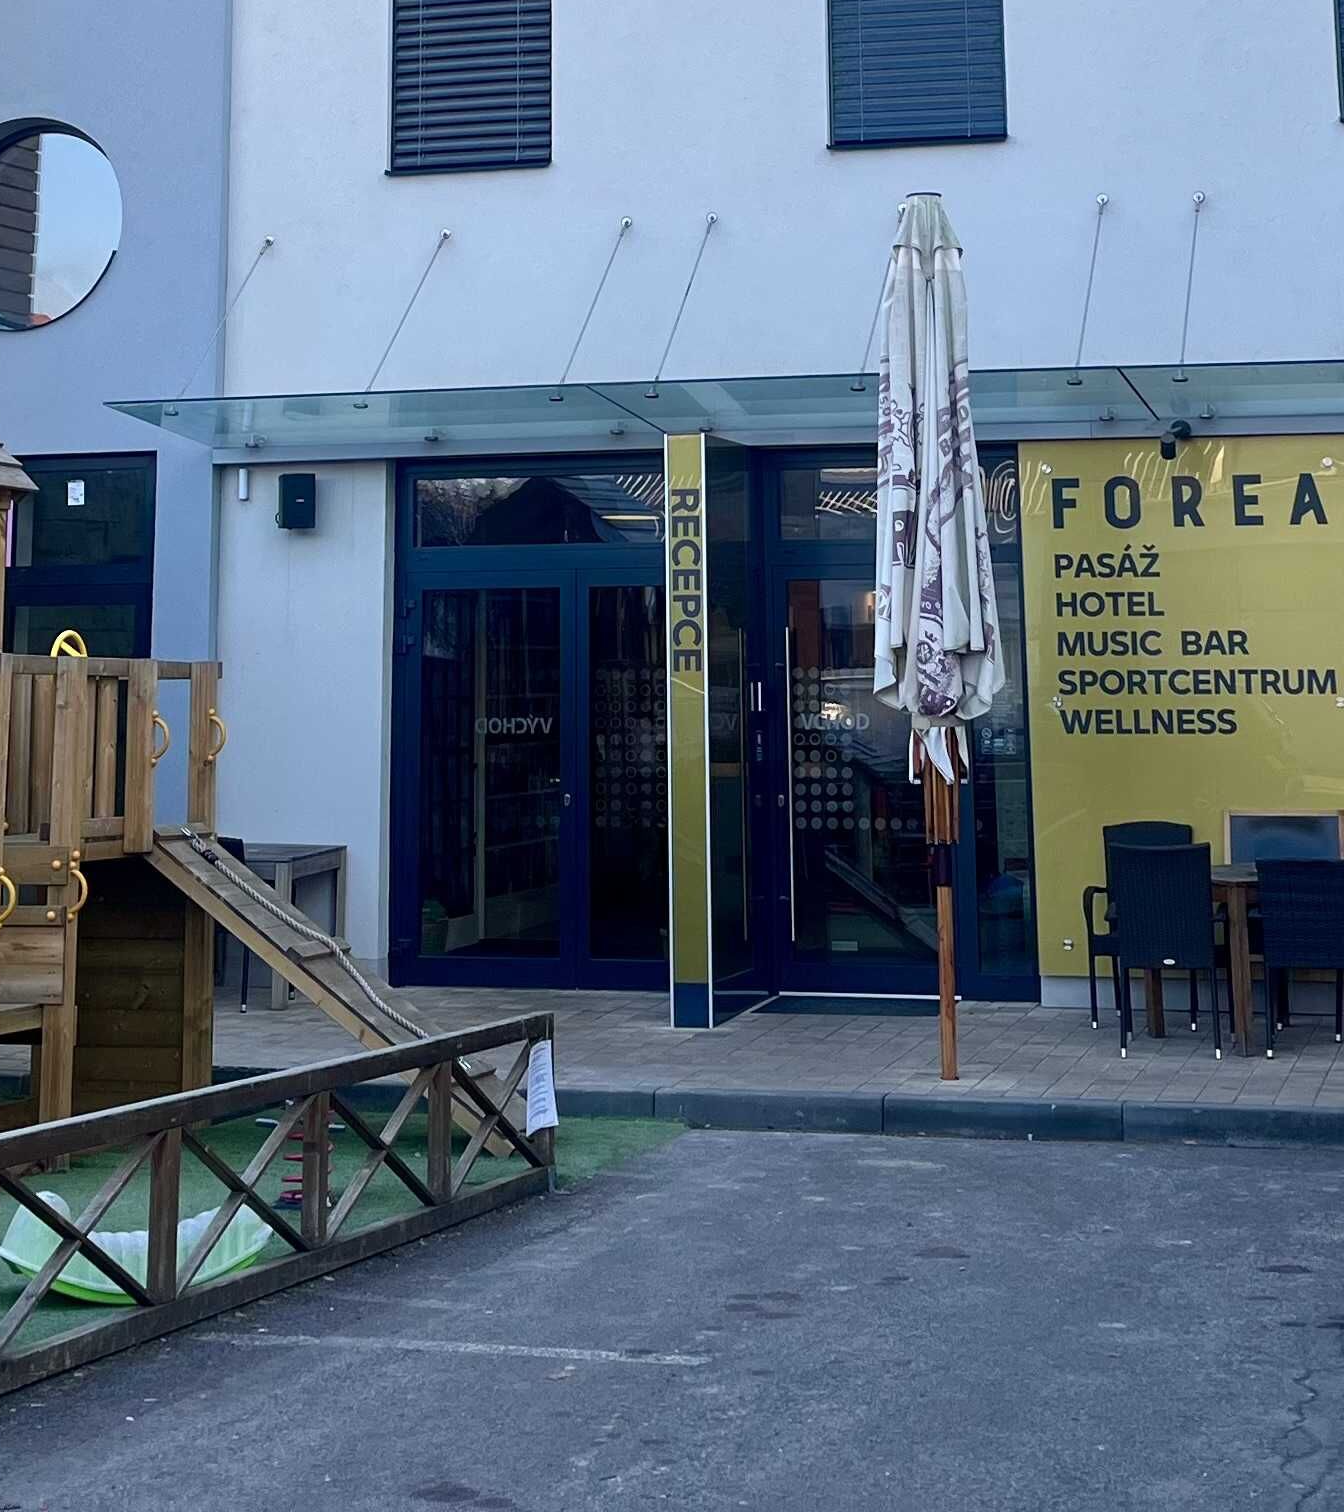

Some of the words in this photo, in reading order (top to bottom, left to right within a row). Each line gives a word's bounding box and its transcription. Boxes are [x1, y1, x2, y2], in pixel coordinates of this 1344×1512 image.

[1051, 472, 1329, 530] FOREA
[1054, 543, 1161, 579] PASÁŽ
[671, 488, 702, 673] RECEPCE
[1056, 591, 1166, 618] HOTEL
[1057, 630, 1163, 657] MUSIC
[1180, 630, 1250, 656] BAR
[1058, 669, 1338, 696] SPORTCENTRUM
[1060, 708, 1238, 735] WELLNESS
